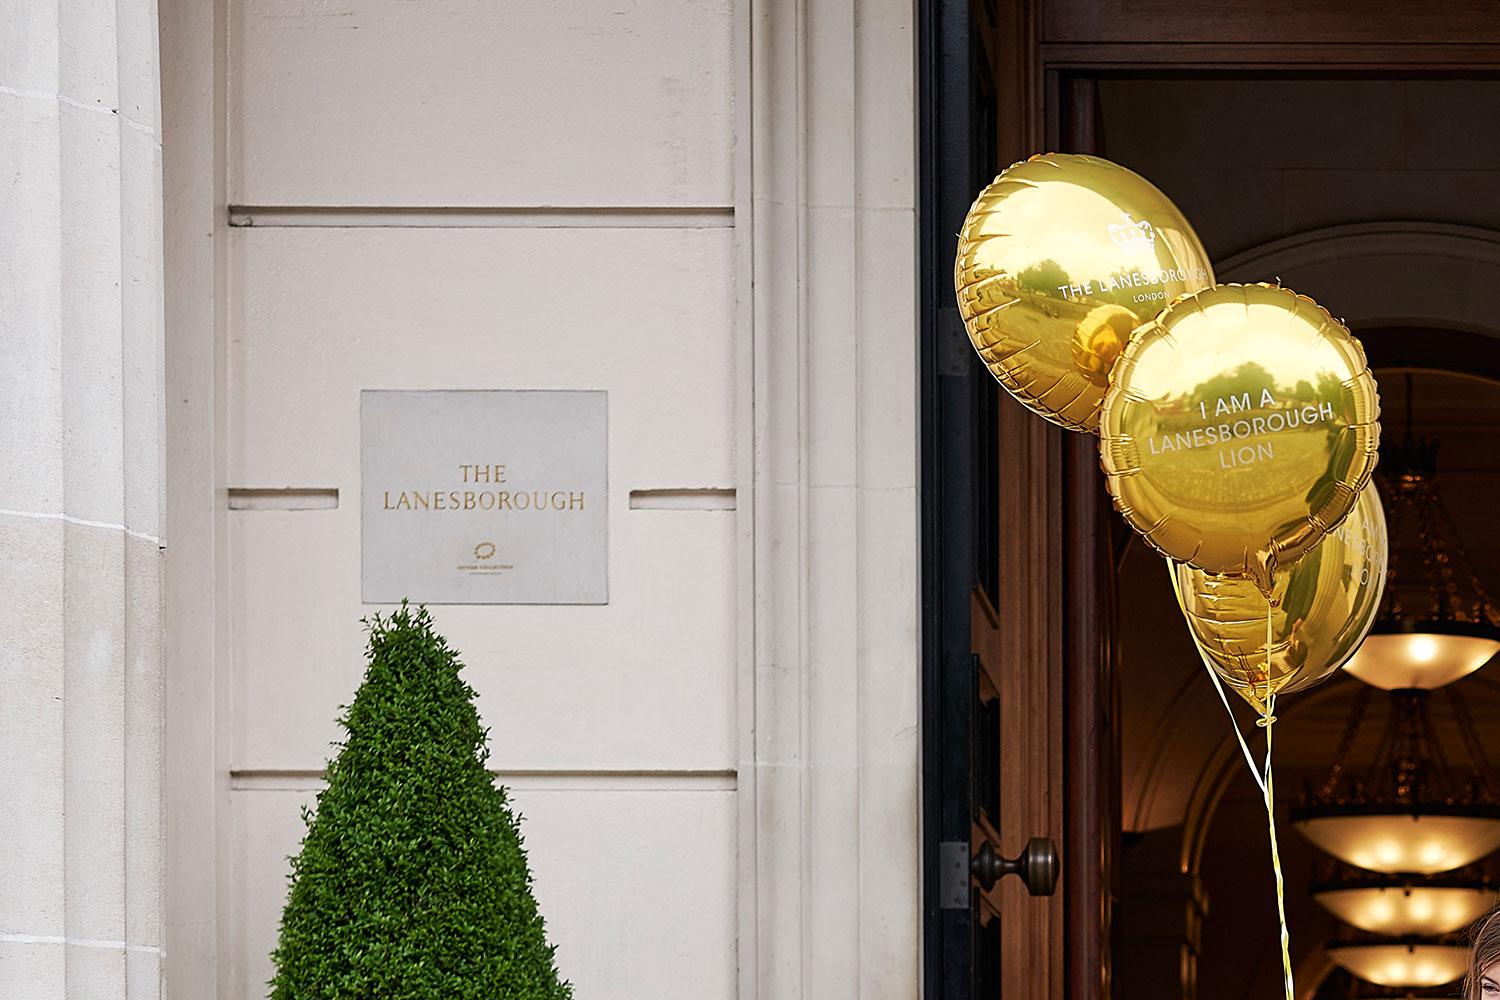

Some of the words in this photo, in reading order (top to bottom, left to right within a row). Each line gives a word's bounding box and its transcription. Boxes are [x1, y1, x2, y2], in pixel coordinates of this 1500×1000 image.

[1057, 282, 1093, 300] THE
[1098, 266, 1208, 293] LANESBOROGH
[1133, 290, 1170, 304] LONDON
[1199, 401, 1207, 420] I
[1214, 391, 1252, 418] AM
[1259, 387, 1277, 409] A
[1147, 400, 1335, 456] LANESBOROUGH
[1218, 441, 1275, 470] LION
[458, 464, 507, 484] THE
[383, 490, 586, 512] LANESBOROUGH
